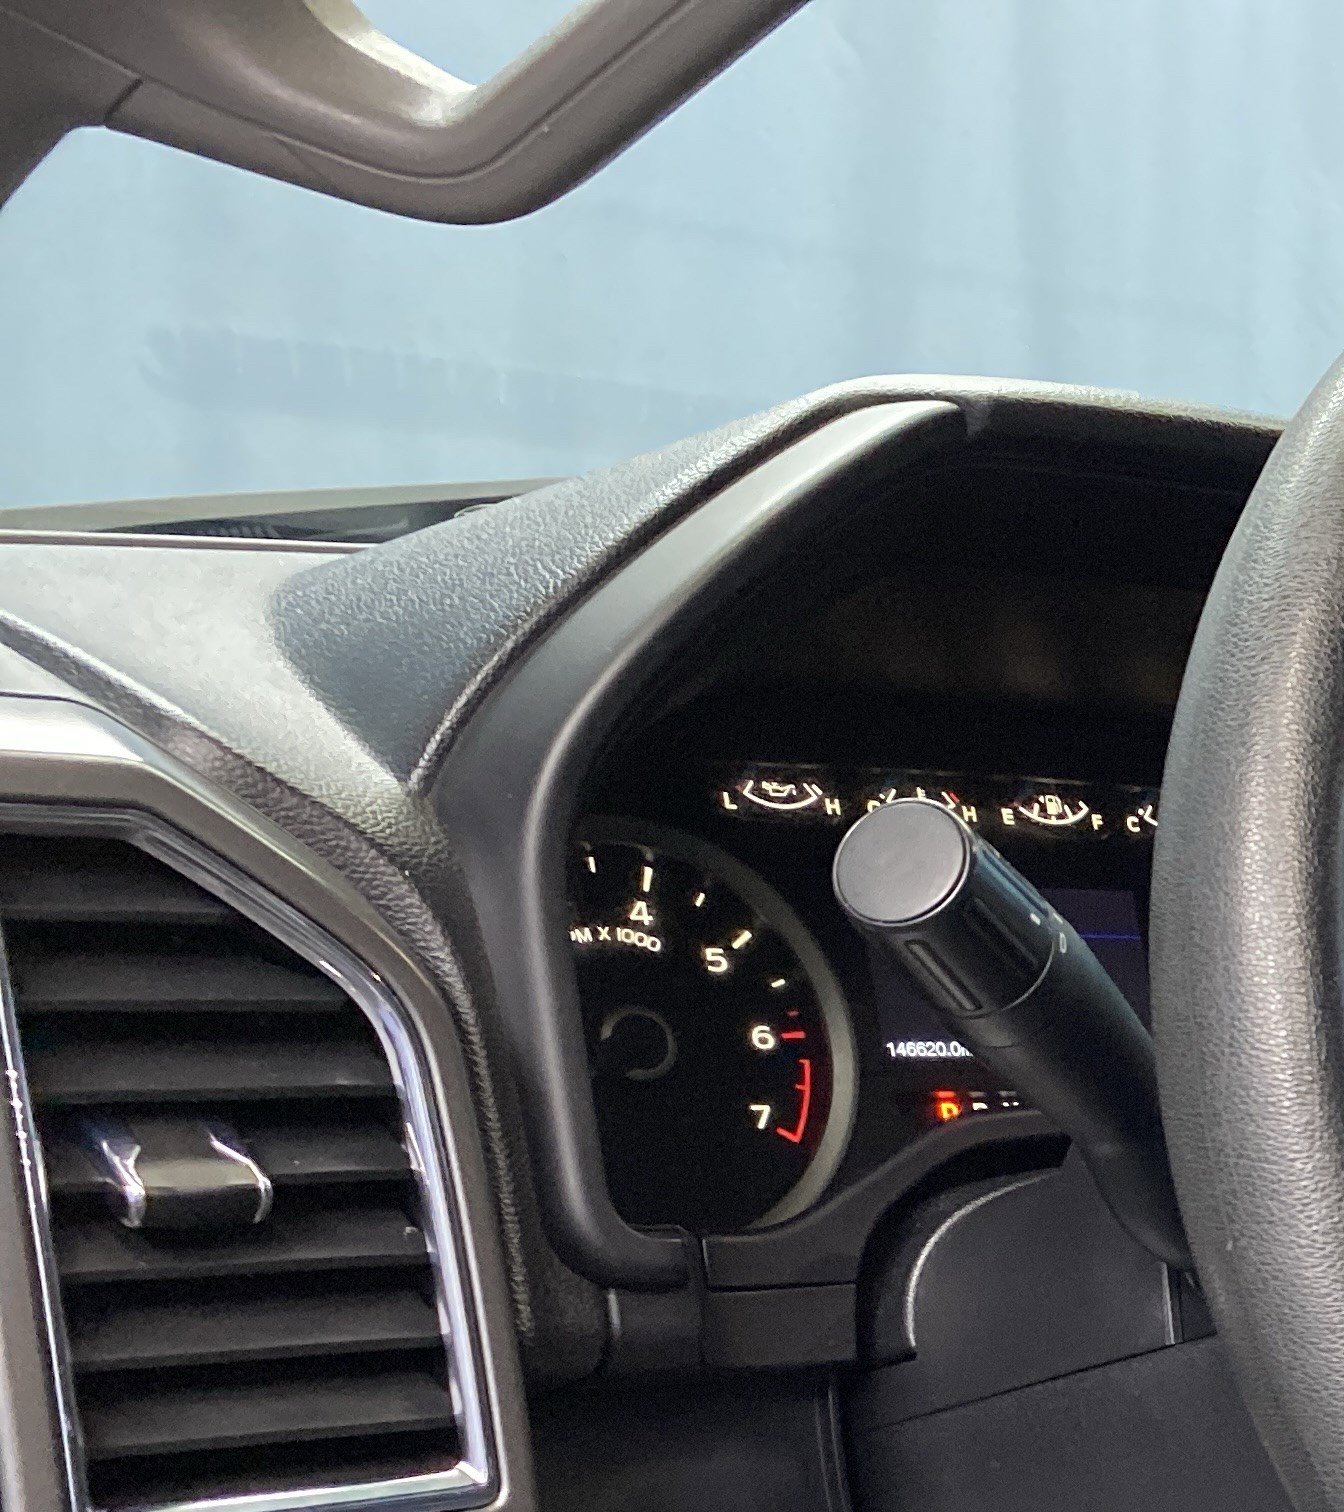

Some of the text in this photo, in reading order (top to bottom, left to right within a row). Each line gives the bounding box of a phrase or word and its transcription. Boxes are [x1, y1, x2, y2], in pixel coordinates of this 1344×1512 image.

[723, 791, 738, 811] L
[825, 798, 842, 816] H
[962, 806, 978, 823] H
[1002, 808, 1016, 825] E
[1091, 814, 1104, 830] F
[1127, 816, 1140, 832] C
[629, 900, 654, 925] 4
[616, 926, 661, 952] 1000
[705, 947, 728, 972] 5
[751, 1025, 776, 1050] 6
[750, 1104, 770, 1130] 7
